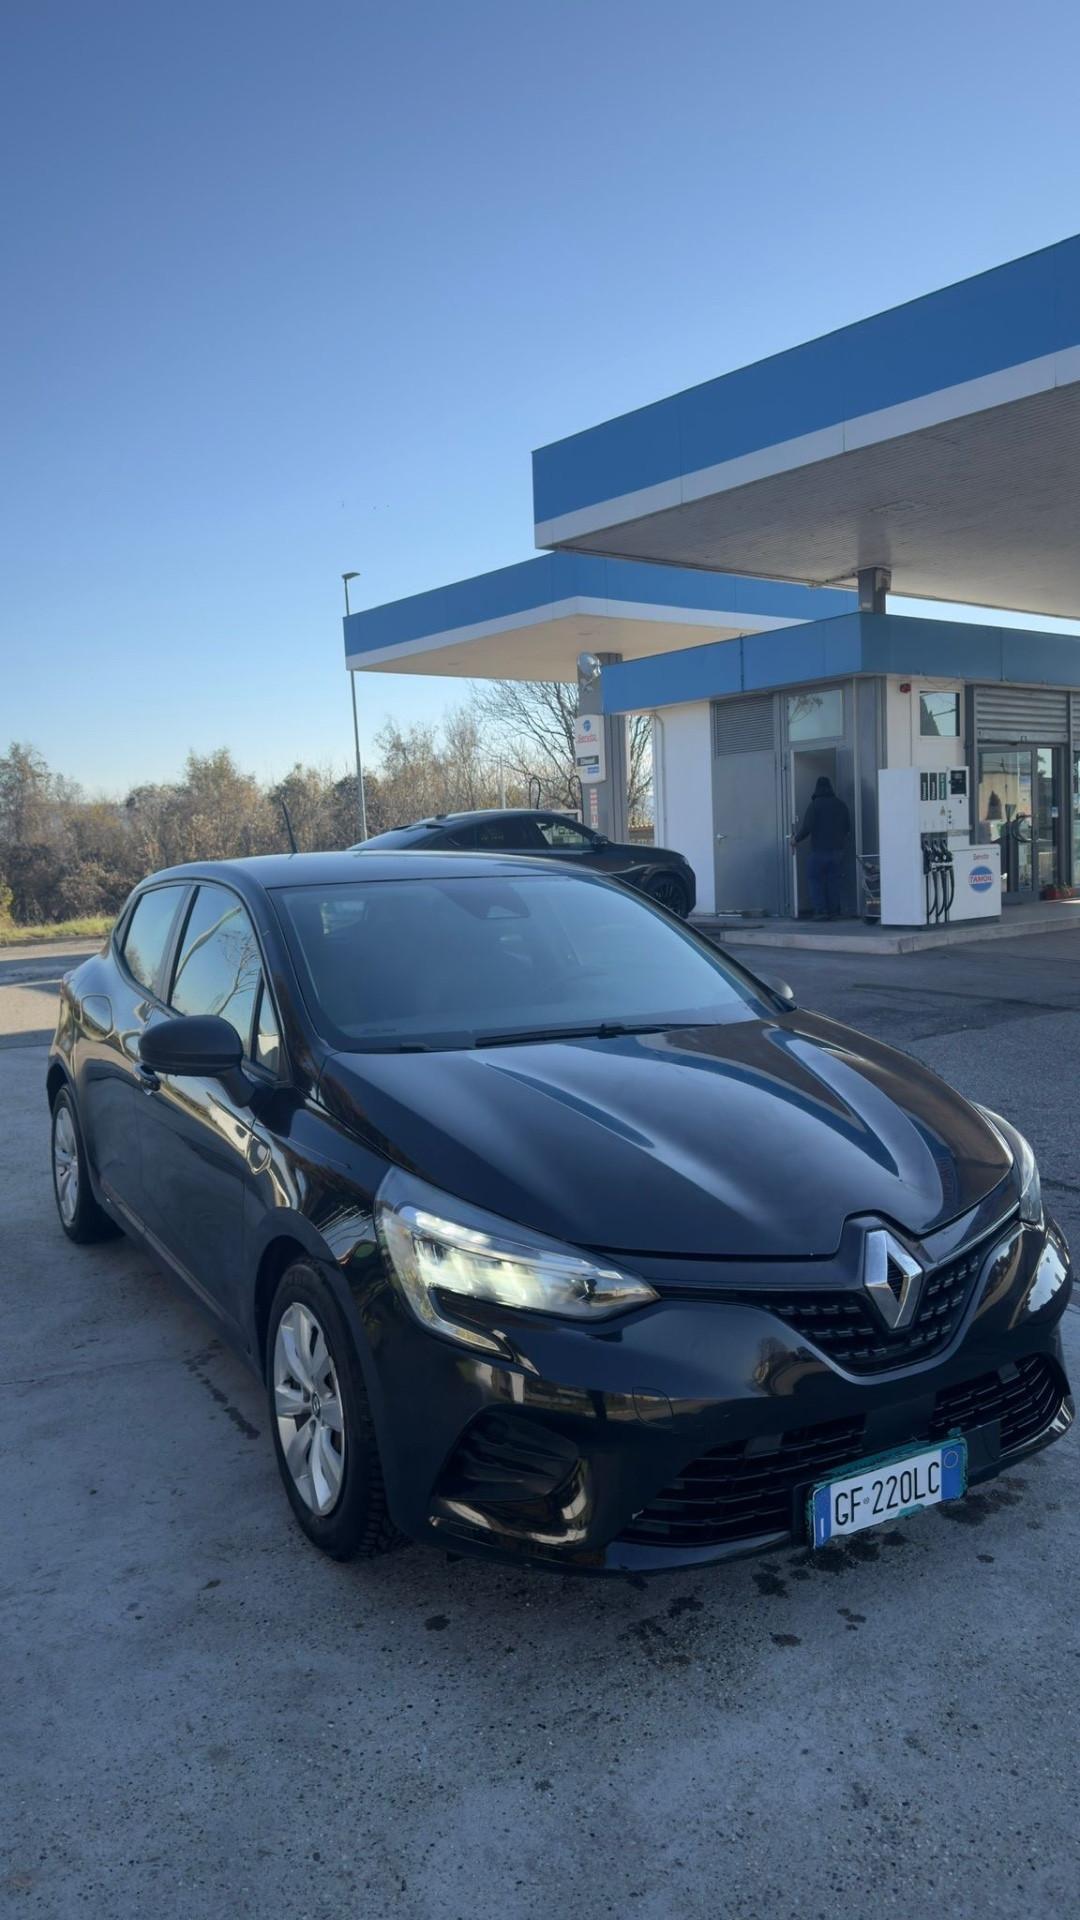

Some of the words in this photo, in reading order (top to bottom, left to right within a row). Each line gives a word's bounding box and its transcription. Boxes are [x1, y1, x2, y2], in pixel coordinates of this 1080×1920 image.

[968, 874, 993, 884] TAMOIL
[835, 1486, 863, 1526] GF
[871, 1461, 940, 1515] 220LC
